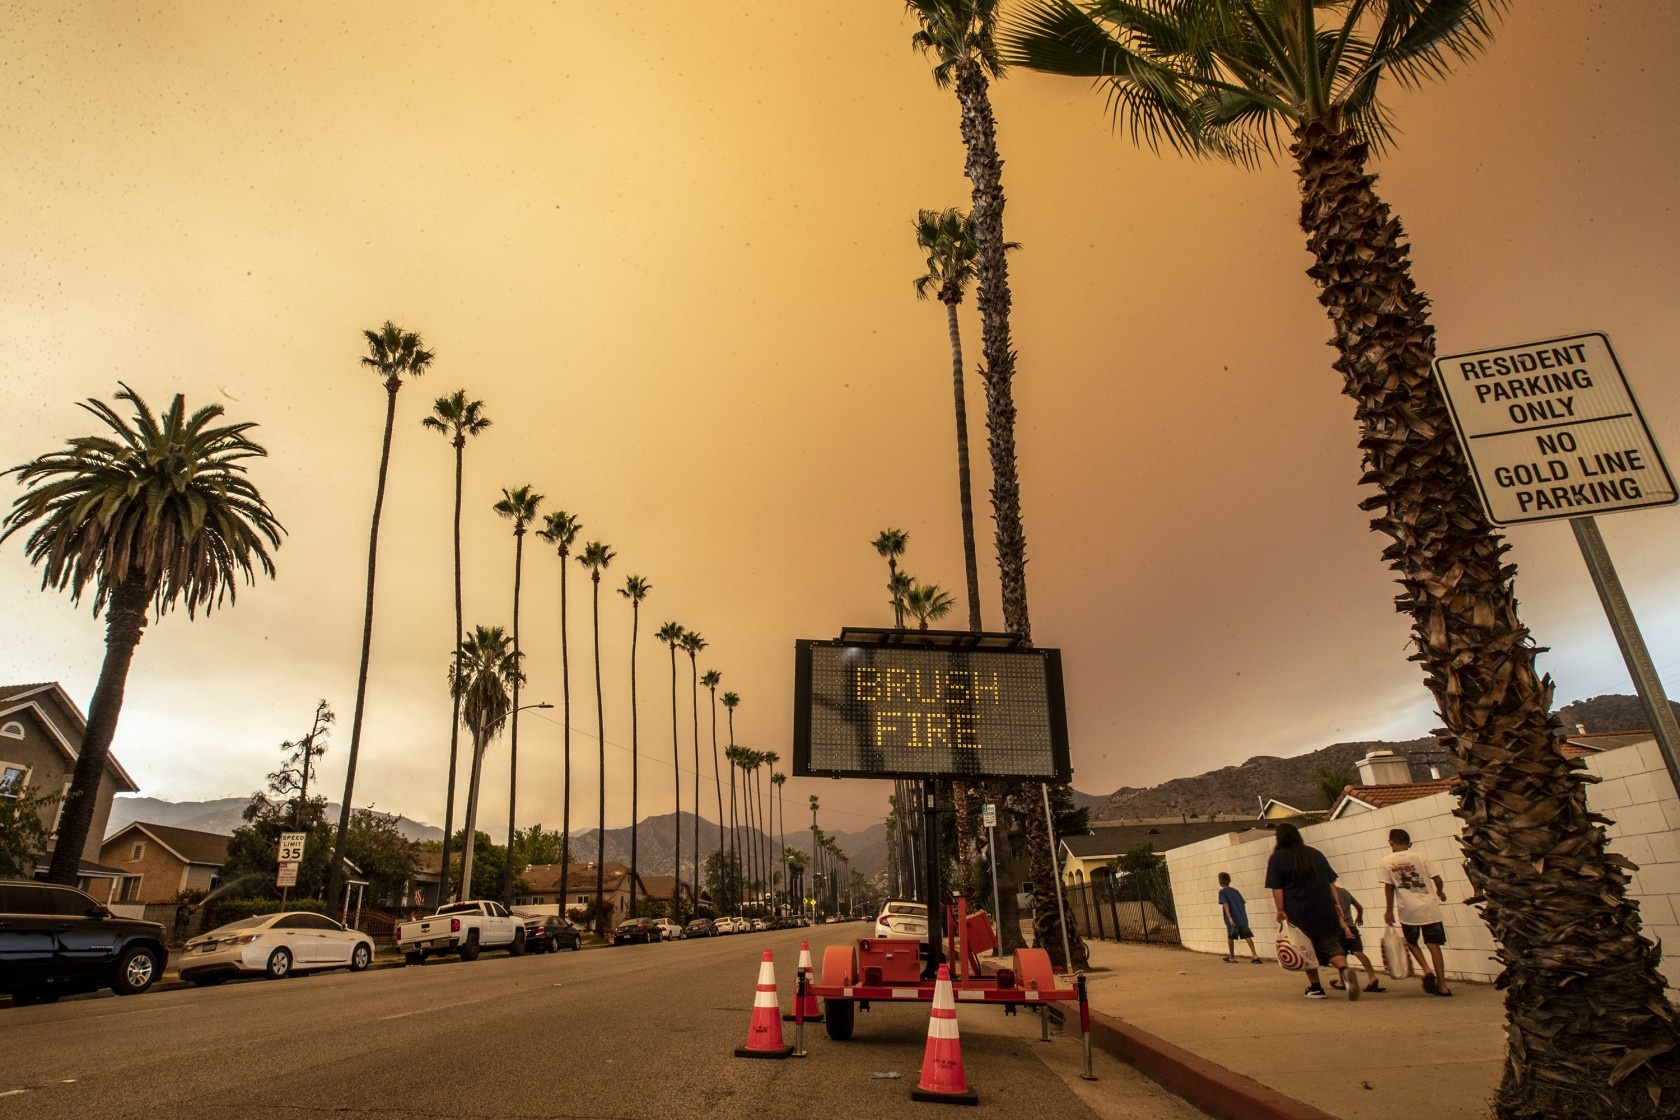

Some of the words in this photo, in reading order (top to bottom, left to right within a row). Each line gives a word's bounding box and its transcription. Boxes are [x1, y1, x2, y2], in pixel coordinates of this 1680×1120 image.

[1460, 344, 1587, 381] RESIDENT
[1475, 369, 1593, 404] PARKING
[1508, 396, 1575, 424] ONLY
[1536, 432, 1577, 455] NO
[1494, 460, 1569, 488] GOLD
[1578, 449, 1645, 477] LINE
[1516, 477, 1642, 512] PARKING
[857, 667, 999, 705] BRUSH
[877, 712, 982, 749] FIRE
[281, 848, 301, 859] 35
